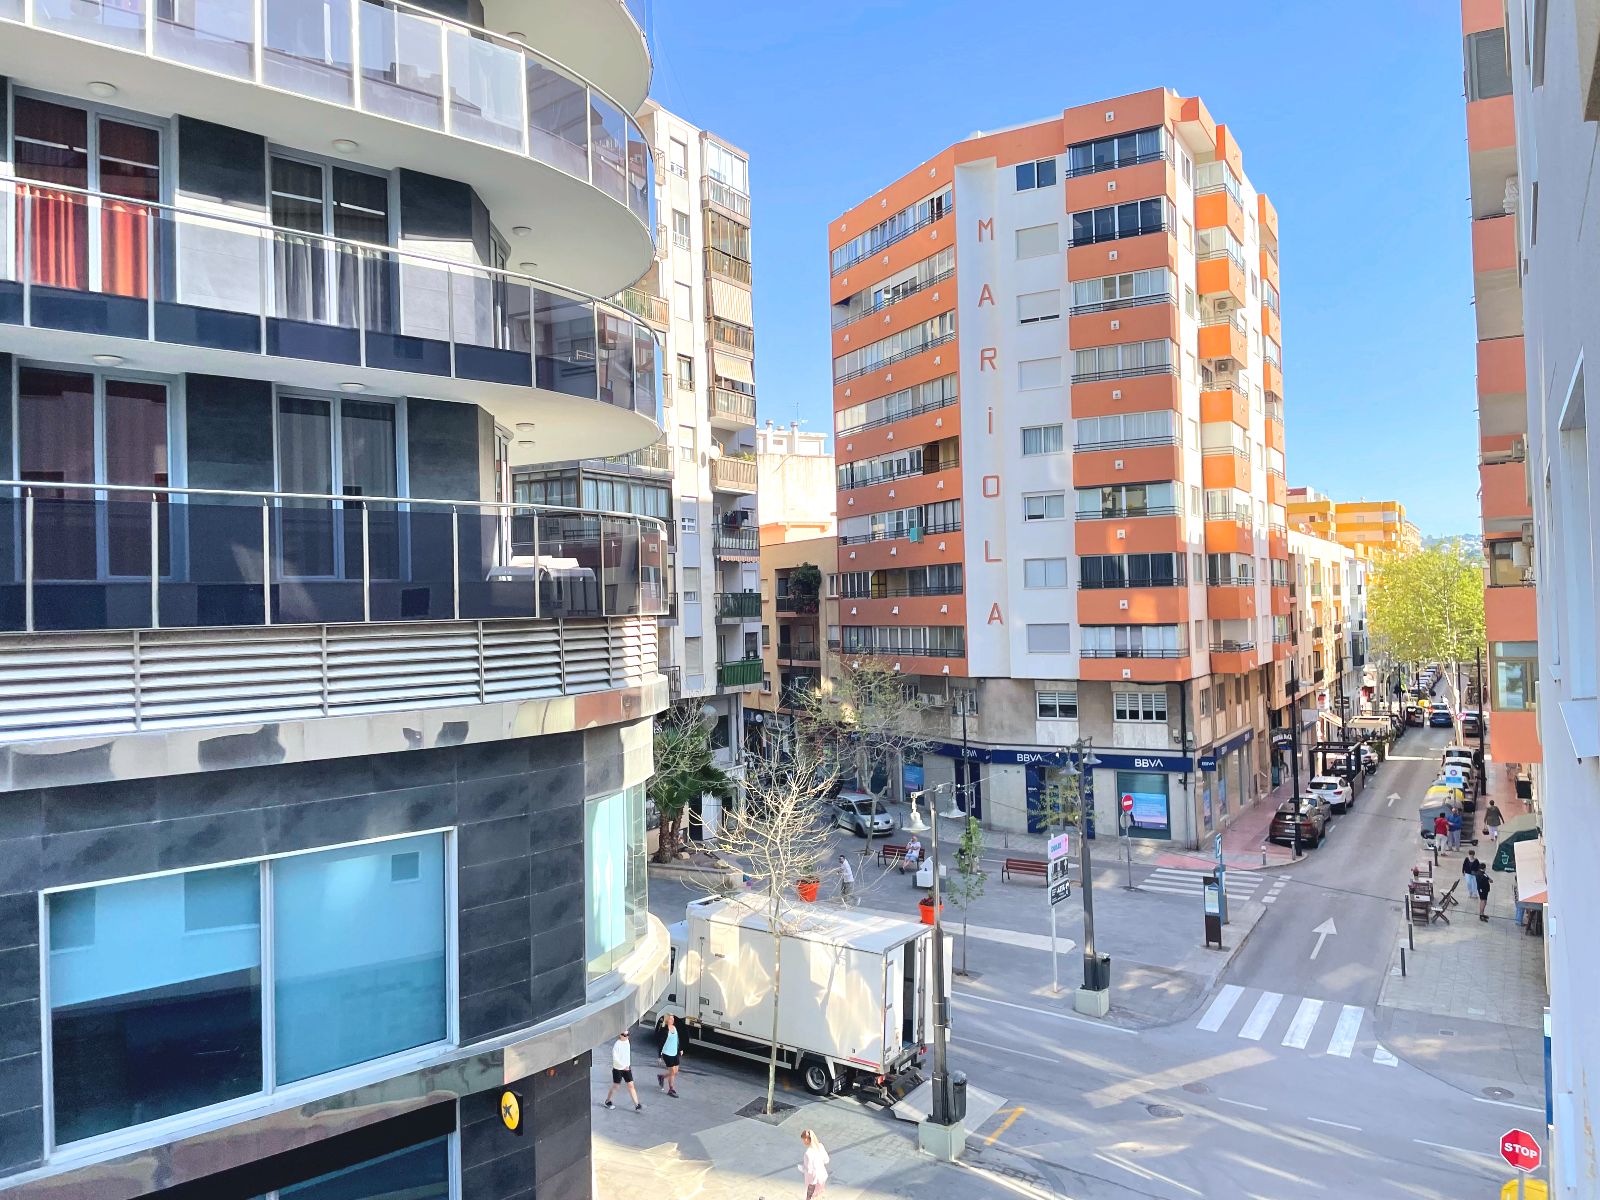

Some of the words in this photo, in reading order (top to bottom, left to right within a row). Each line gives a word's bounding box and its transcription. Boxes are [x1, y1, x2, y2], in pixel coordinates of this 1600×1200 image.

[1017, 753, 1042, 762] BBVA
[1134, 758, 1164, 768] BBVA
[1504, 1142, 1538, 1159] STOP
